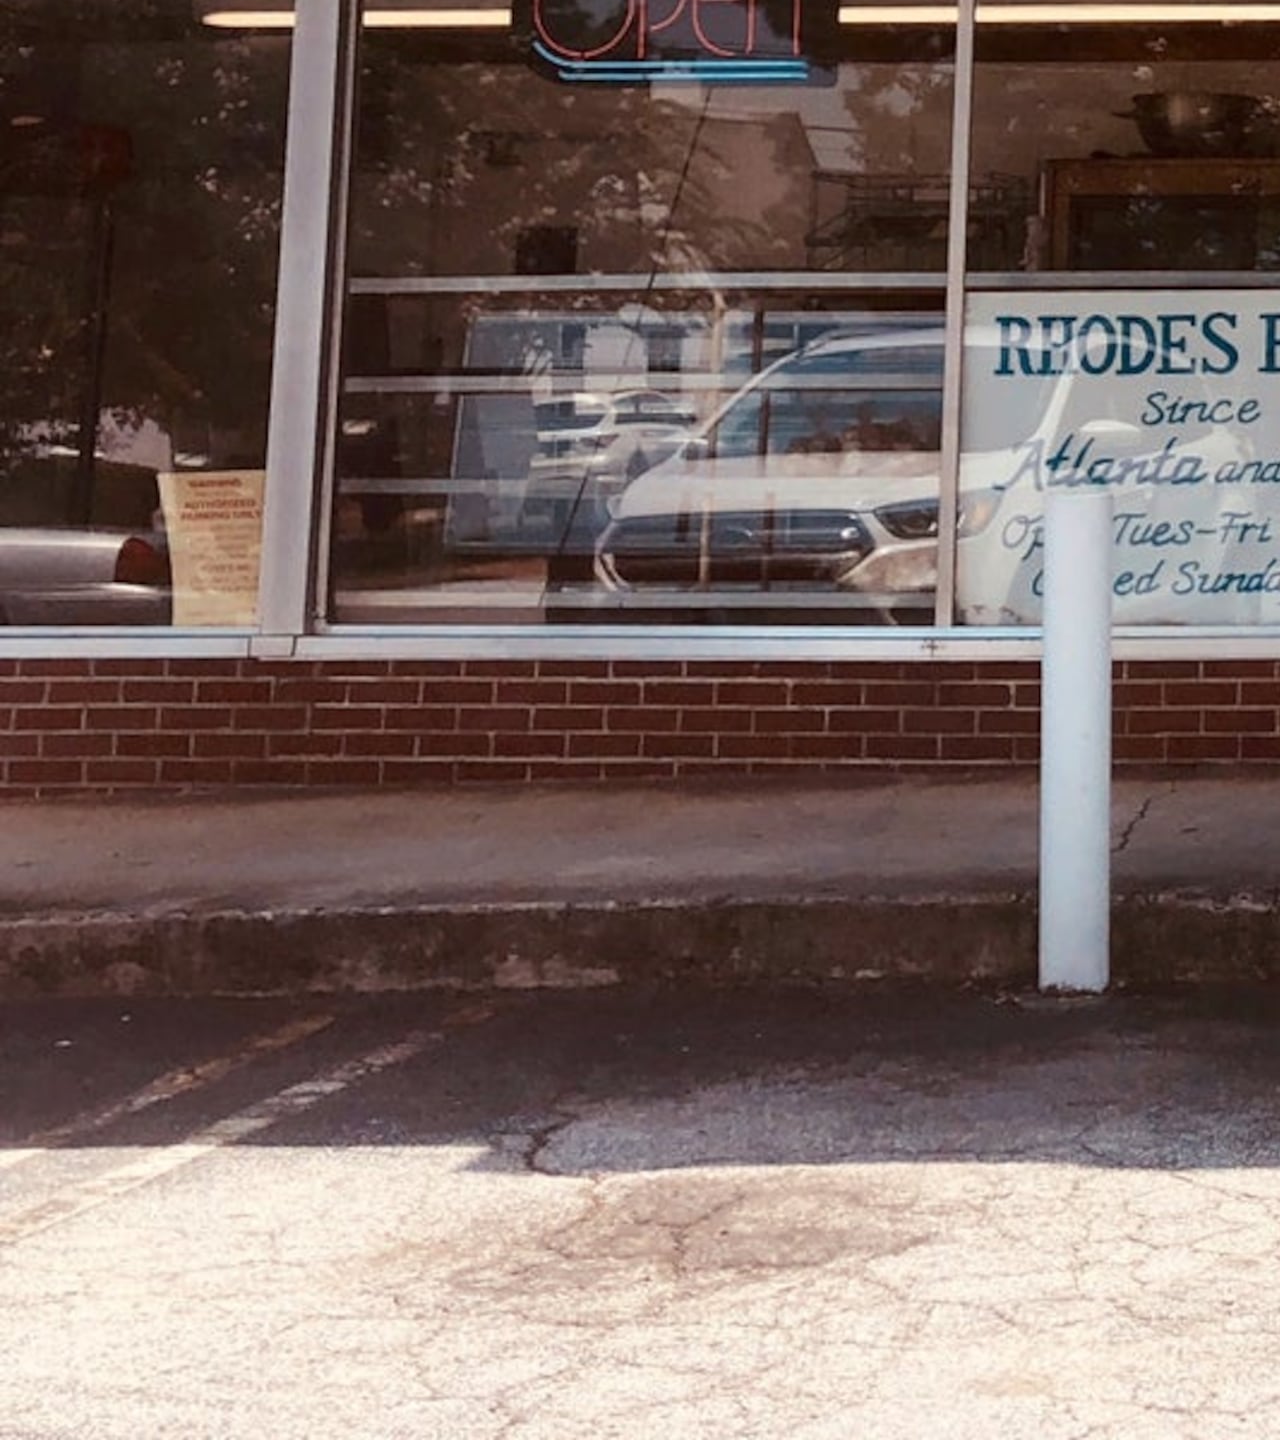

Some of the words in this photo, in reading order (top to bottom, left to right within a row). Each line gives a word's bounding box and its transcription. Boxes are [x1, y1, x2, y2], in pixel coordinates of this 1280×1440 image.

[994, 312, 1239, 375] RHODES
[1141, 391, 1261, 425] Since
[992, 433, 1208, 491] Atlanta
